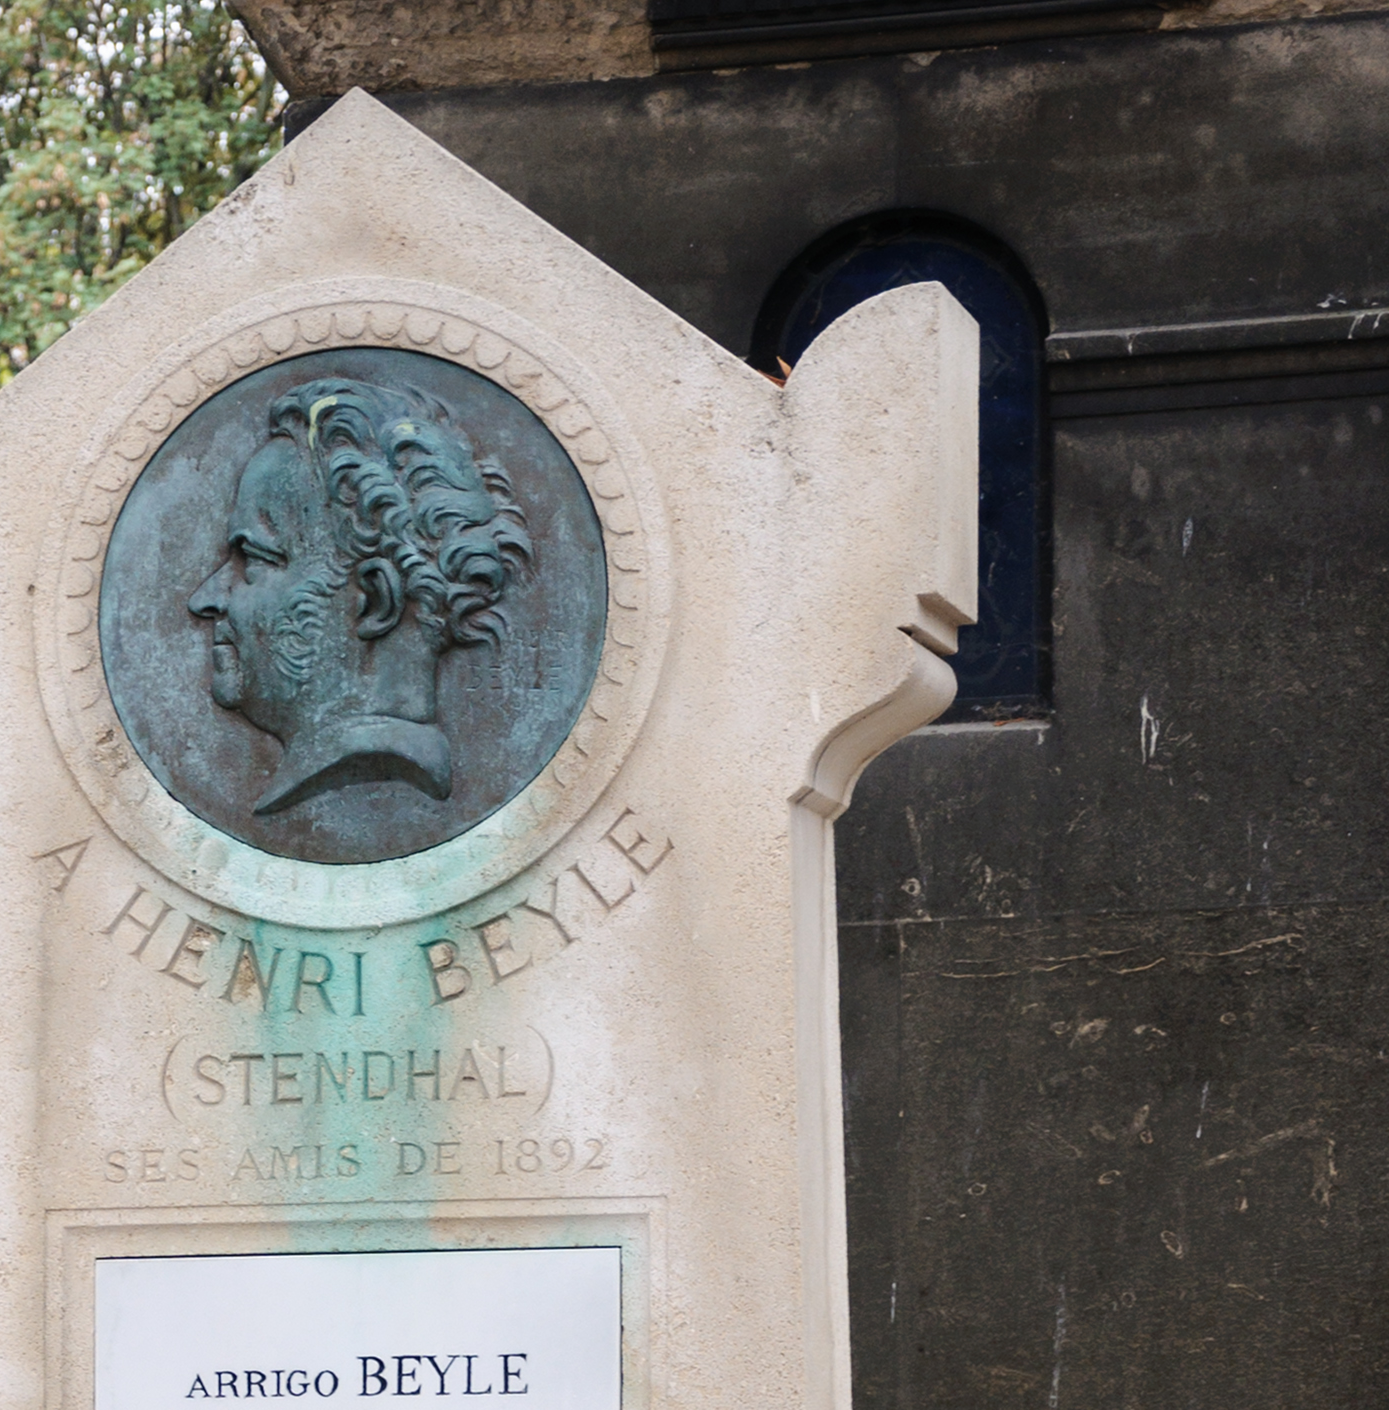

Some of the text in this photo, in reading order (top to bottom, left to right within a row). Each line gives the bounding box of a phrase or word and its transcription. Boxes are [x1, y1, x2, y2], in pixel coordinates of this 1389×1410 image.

[31, 806, 676, 1018] A HENRI BEYLE
[161, 1024, 554, 1122] (STENDHAL)
[103, 1137, 606, 1185] SES AMIS DE 1892
[186, 1353, 528, 1398] ARRIGO BEYLE
